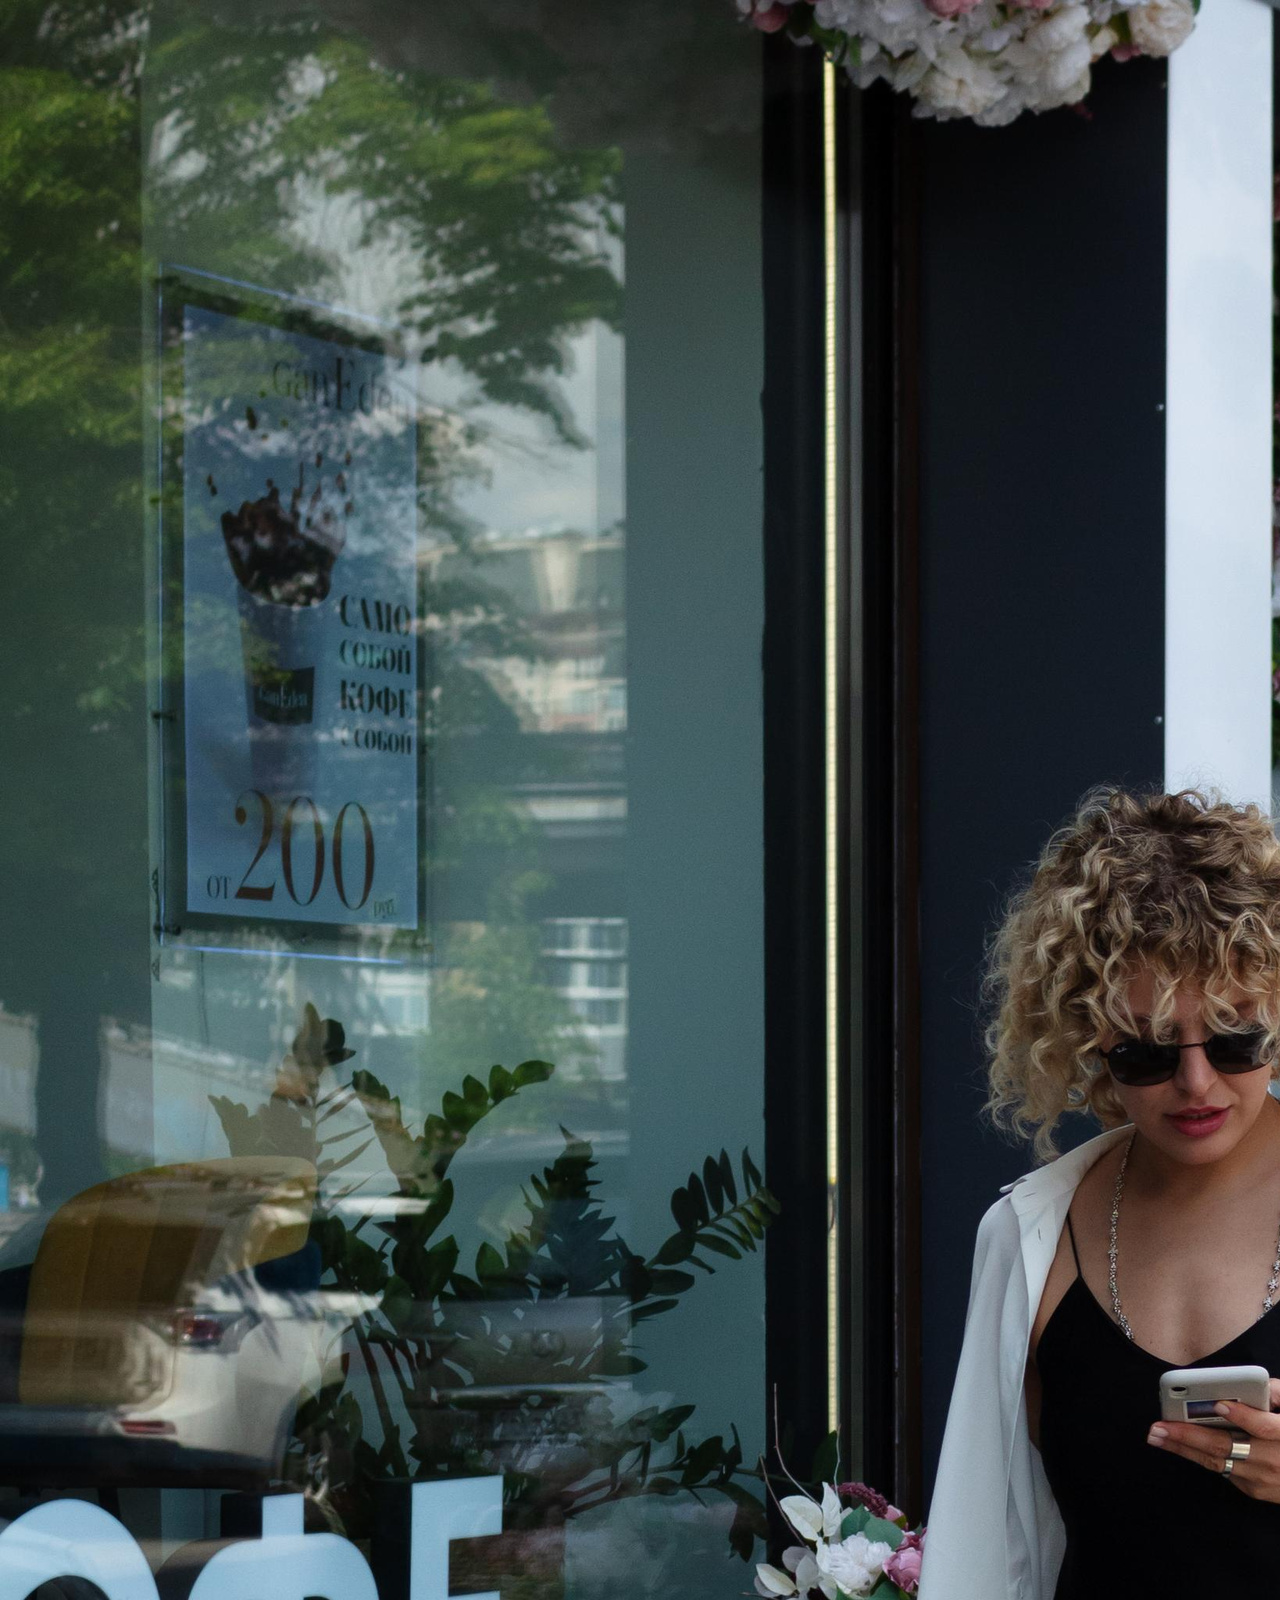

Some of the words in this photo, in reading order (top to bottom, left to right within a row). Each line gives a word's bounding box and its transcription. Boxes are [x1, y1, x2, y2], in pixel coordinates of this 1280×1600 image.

[340, 594, 412, 637] САМО
[340, 679, 412, 719] КОФЕ
[234, 789, 375, 911] 200
